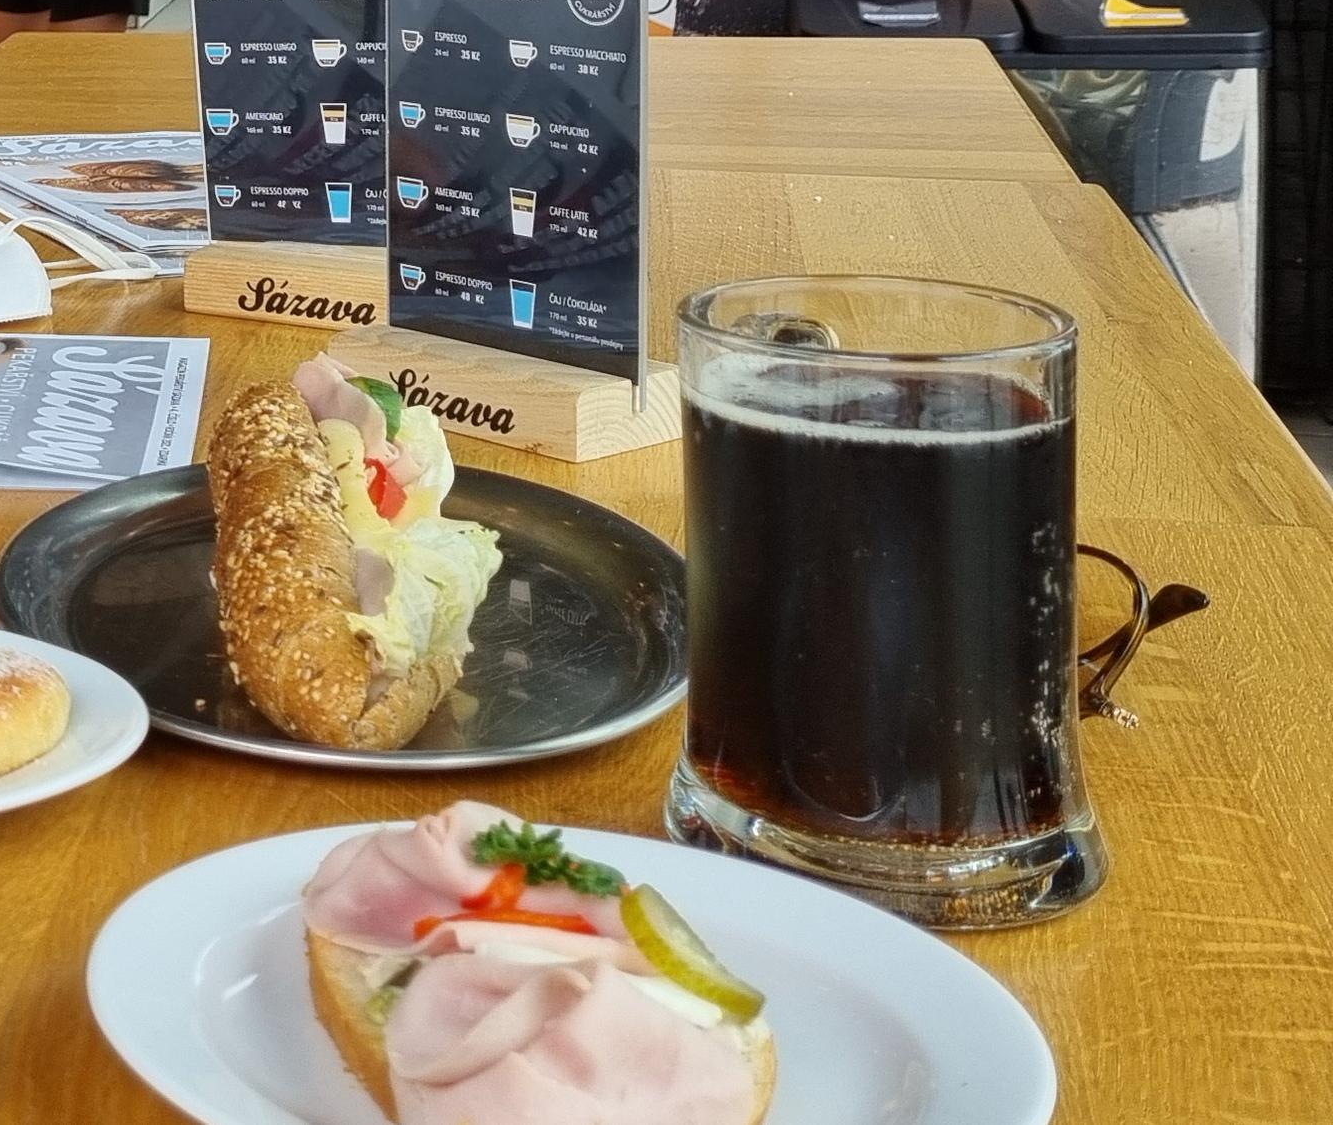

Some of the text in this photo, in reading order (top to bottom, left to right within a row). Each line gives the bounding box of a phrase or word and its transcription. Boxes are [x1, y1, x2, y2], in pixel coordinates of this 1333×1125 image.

[435, 31, 467, 45] ESPRESSO
[240, 42, 297, 52] ESPRESSO LUNGO
[355, 43, 386, 52] CAPPUCI
[549, 45, 627, 63] ESPRESSO MACCHIATO
[245, 112, 284, 122] AMERICANO
[435, 106, 491, 124] ESPRESSO LUNGO
[549, 123, 590, 138] CAPPUCINO
[577, 142, 588, 154] 42
[250, 186, 309, 196] ESPRESSO DOPPIO
[435, 188, 474, 202] AMERICANO
[549, 206, 590, 222] CAFFE LATTE
[435, 271, 493, 292] ESPRESSO DOPPIO
[237, 277, 377, 326] Sázava
[549, 291, 562, 305] ČAJ
[577, 315, 587, 327] 35
[389, 368, 516, 435] Sázava
